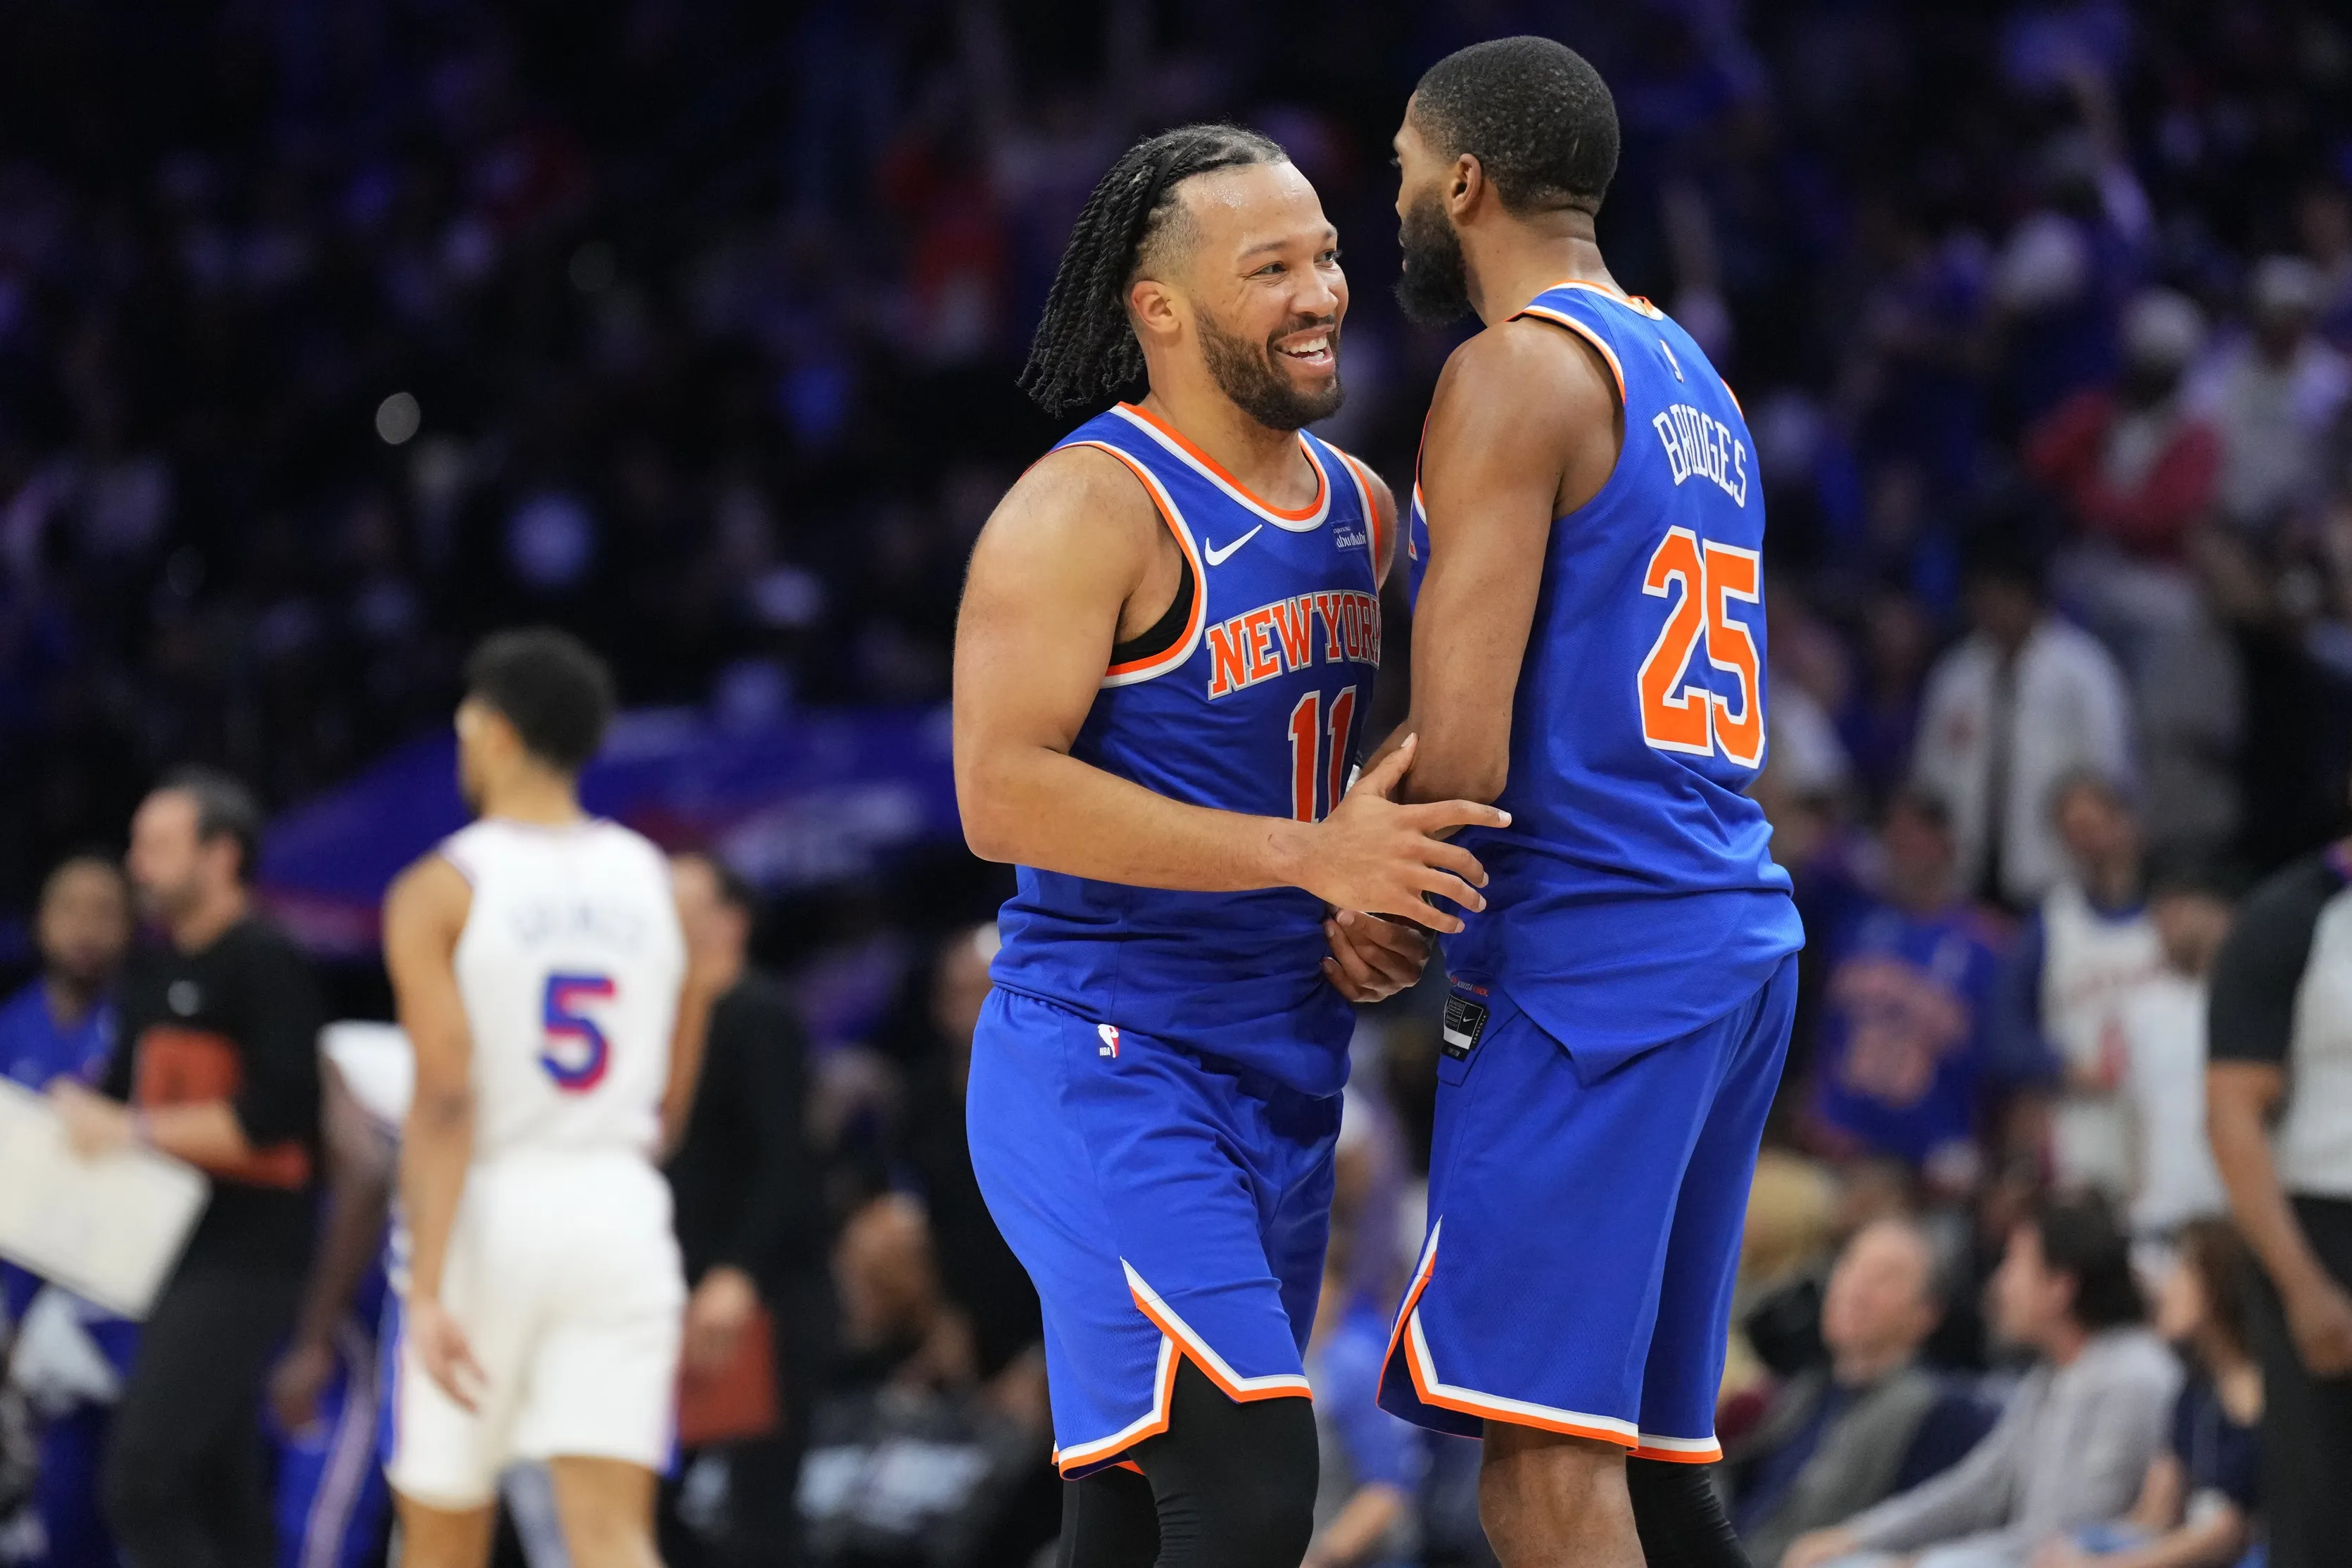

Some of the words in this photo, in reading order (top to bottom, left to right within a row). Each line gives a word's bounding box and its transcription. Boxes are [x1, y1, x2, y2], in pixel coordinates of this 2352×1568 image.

[1652, 404, 1747, 508] BRIDGES
[1205, 592, 1314, 700] NEW
[1637, 525, 1766, 769] 25
[1288, 685, 1356, 823] 11
[540, 970, 617, 1095] 5
[1099, 1047, 1111, 1056] NBA
